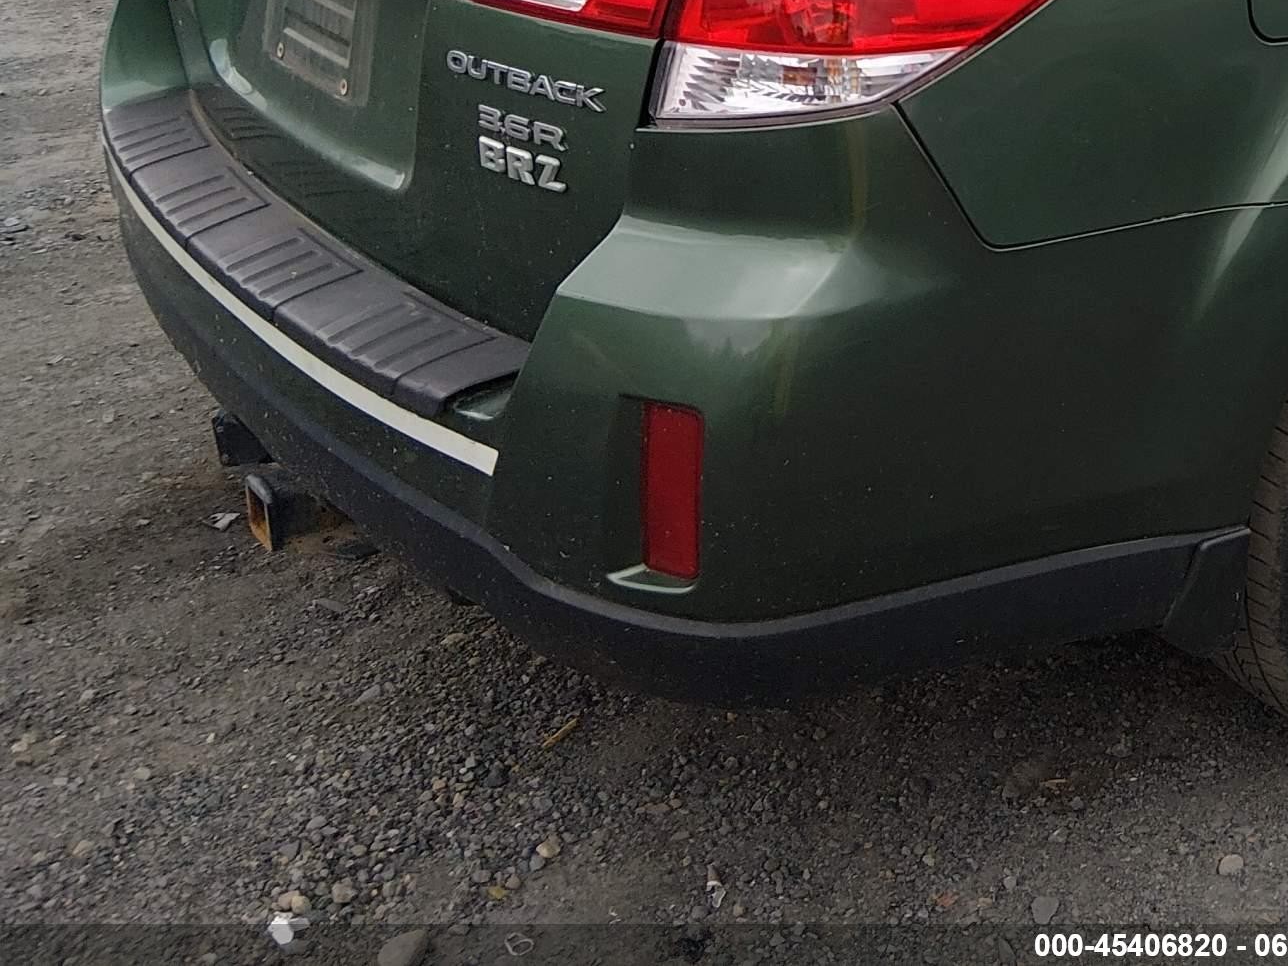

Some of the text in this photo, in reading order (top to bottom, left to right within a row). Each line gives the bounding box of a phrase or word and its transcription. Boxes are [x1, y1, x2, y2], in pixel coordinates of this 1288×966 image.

[446, 49, 607, 112] OUTBACK
[478, 104, 568, 152] 3.6R
[478, 135, 567, 193] BRZ
